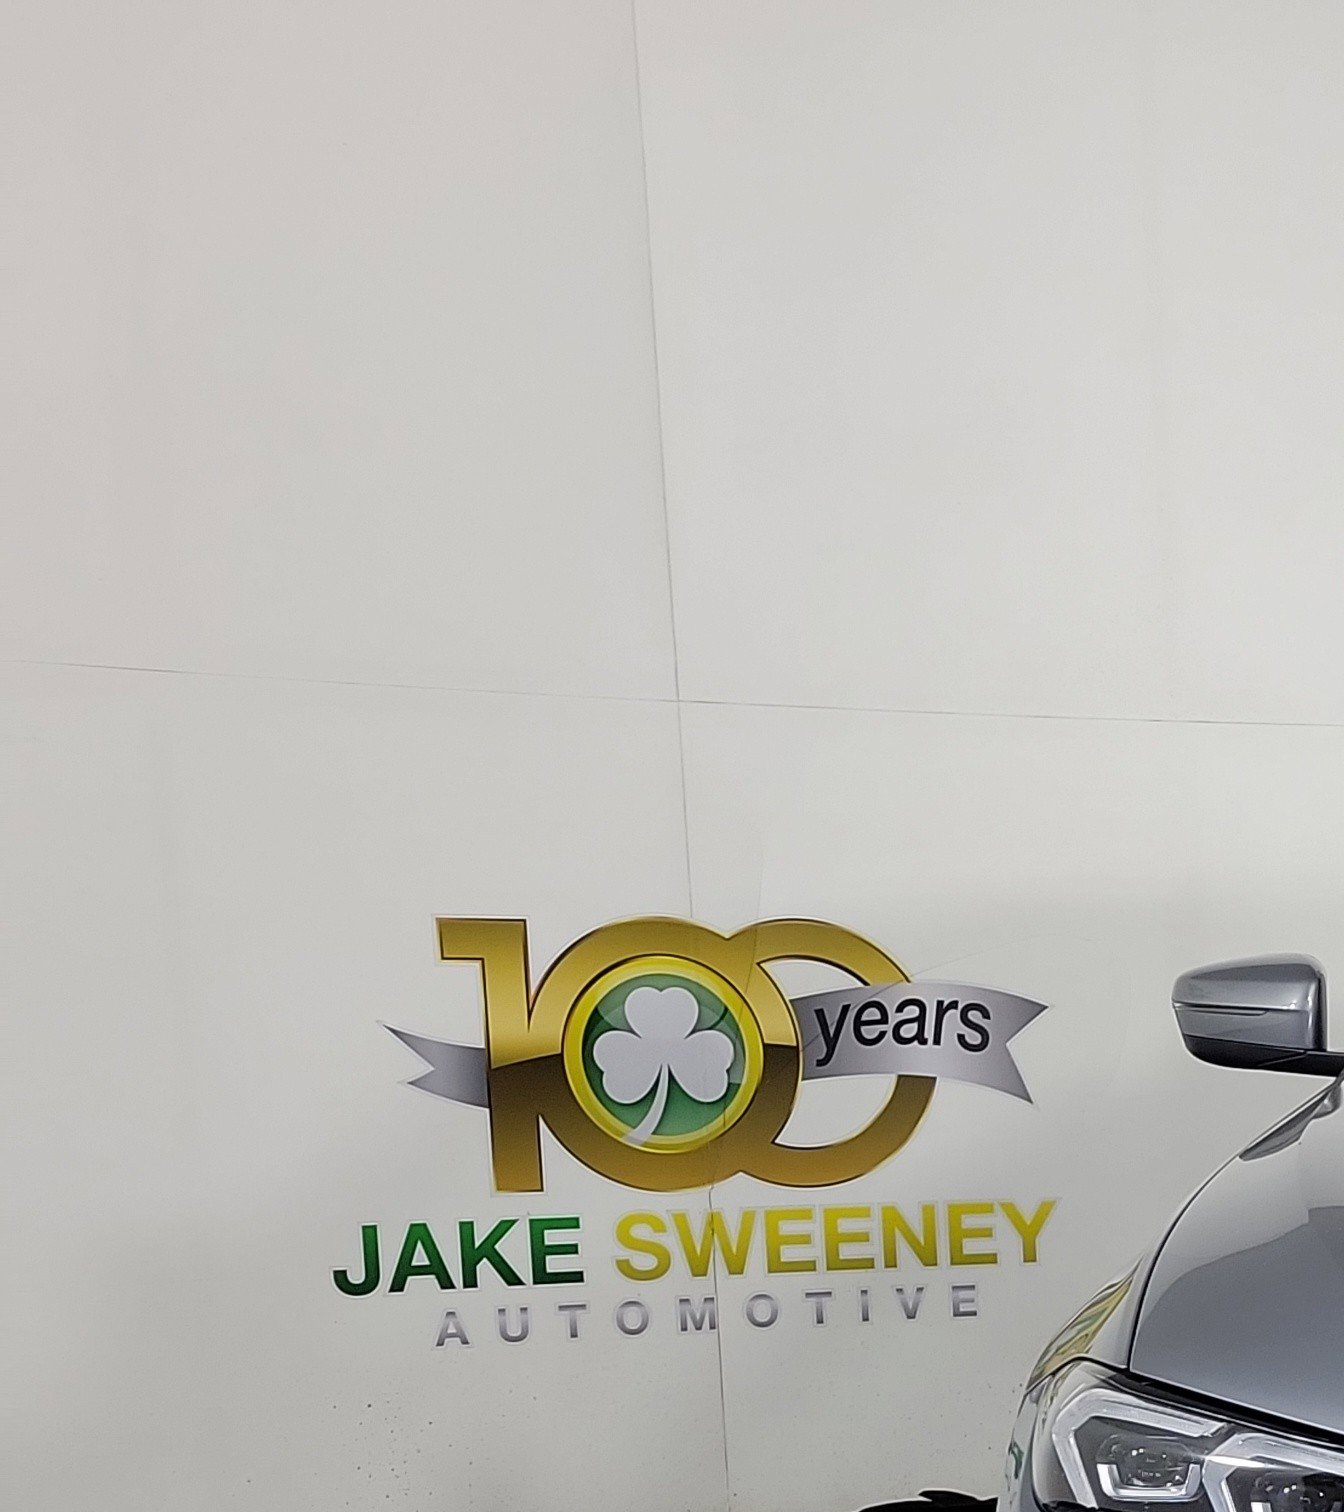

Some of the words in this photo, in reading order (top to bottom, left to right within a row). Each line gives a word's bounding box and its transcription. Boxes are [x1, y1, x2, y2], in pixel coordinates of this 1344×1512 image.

[436, 916, 938, 1191] 100
[812, 998, 992, 1067] years
[332, 1216, 585, 1297] JAKE
[614, 1200, 1058, 1282] SWEENEY
[436, 1284, 978, 1349] AUTOMOTIVE
